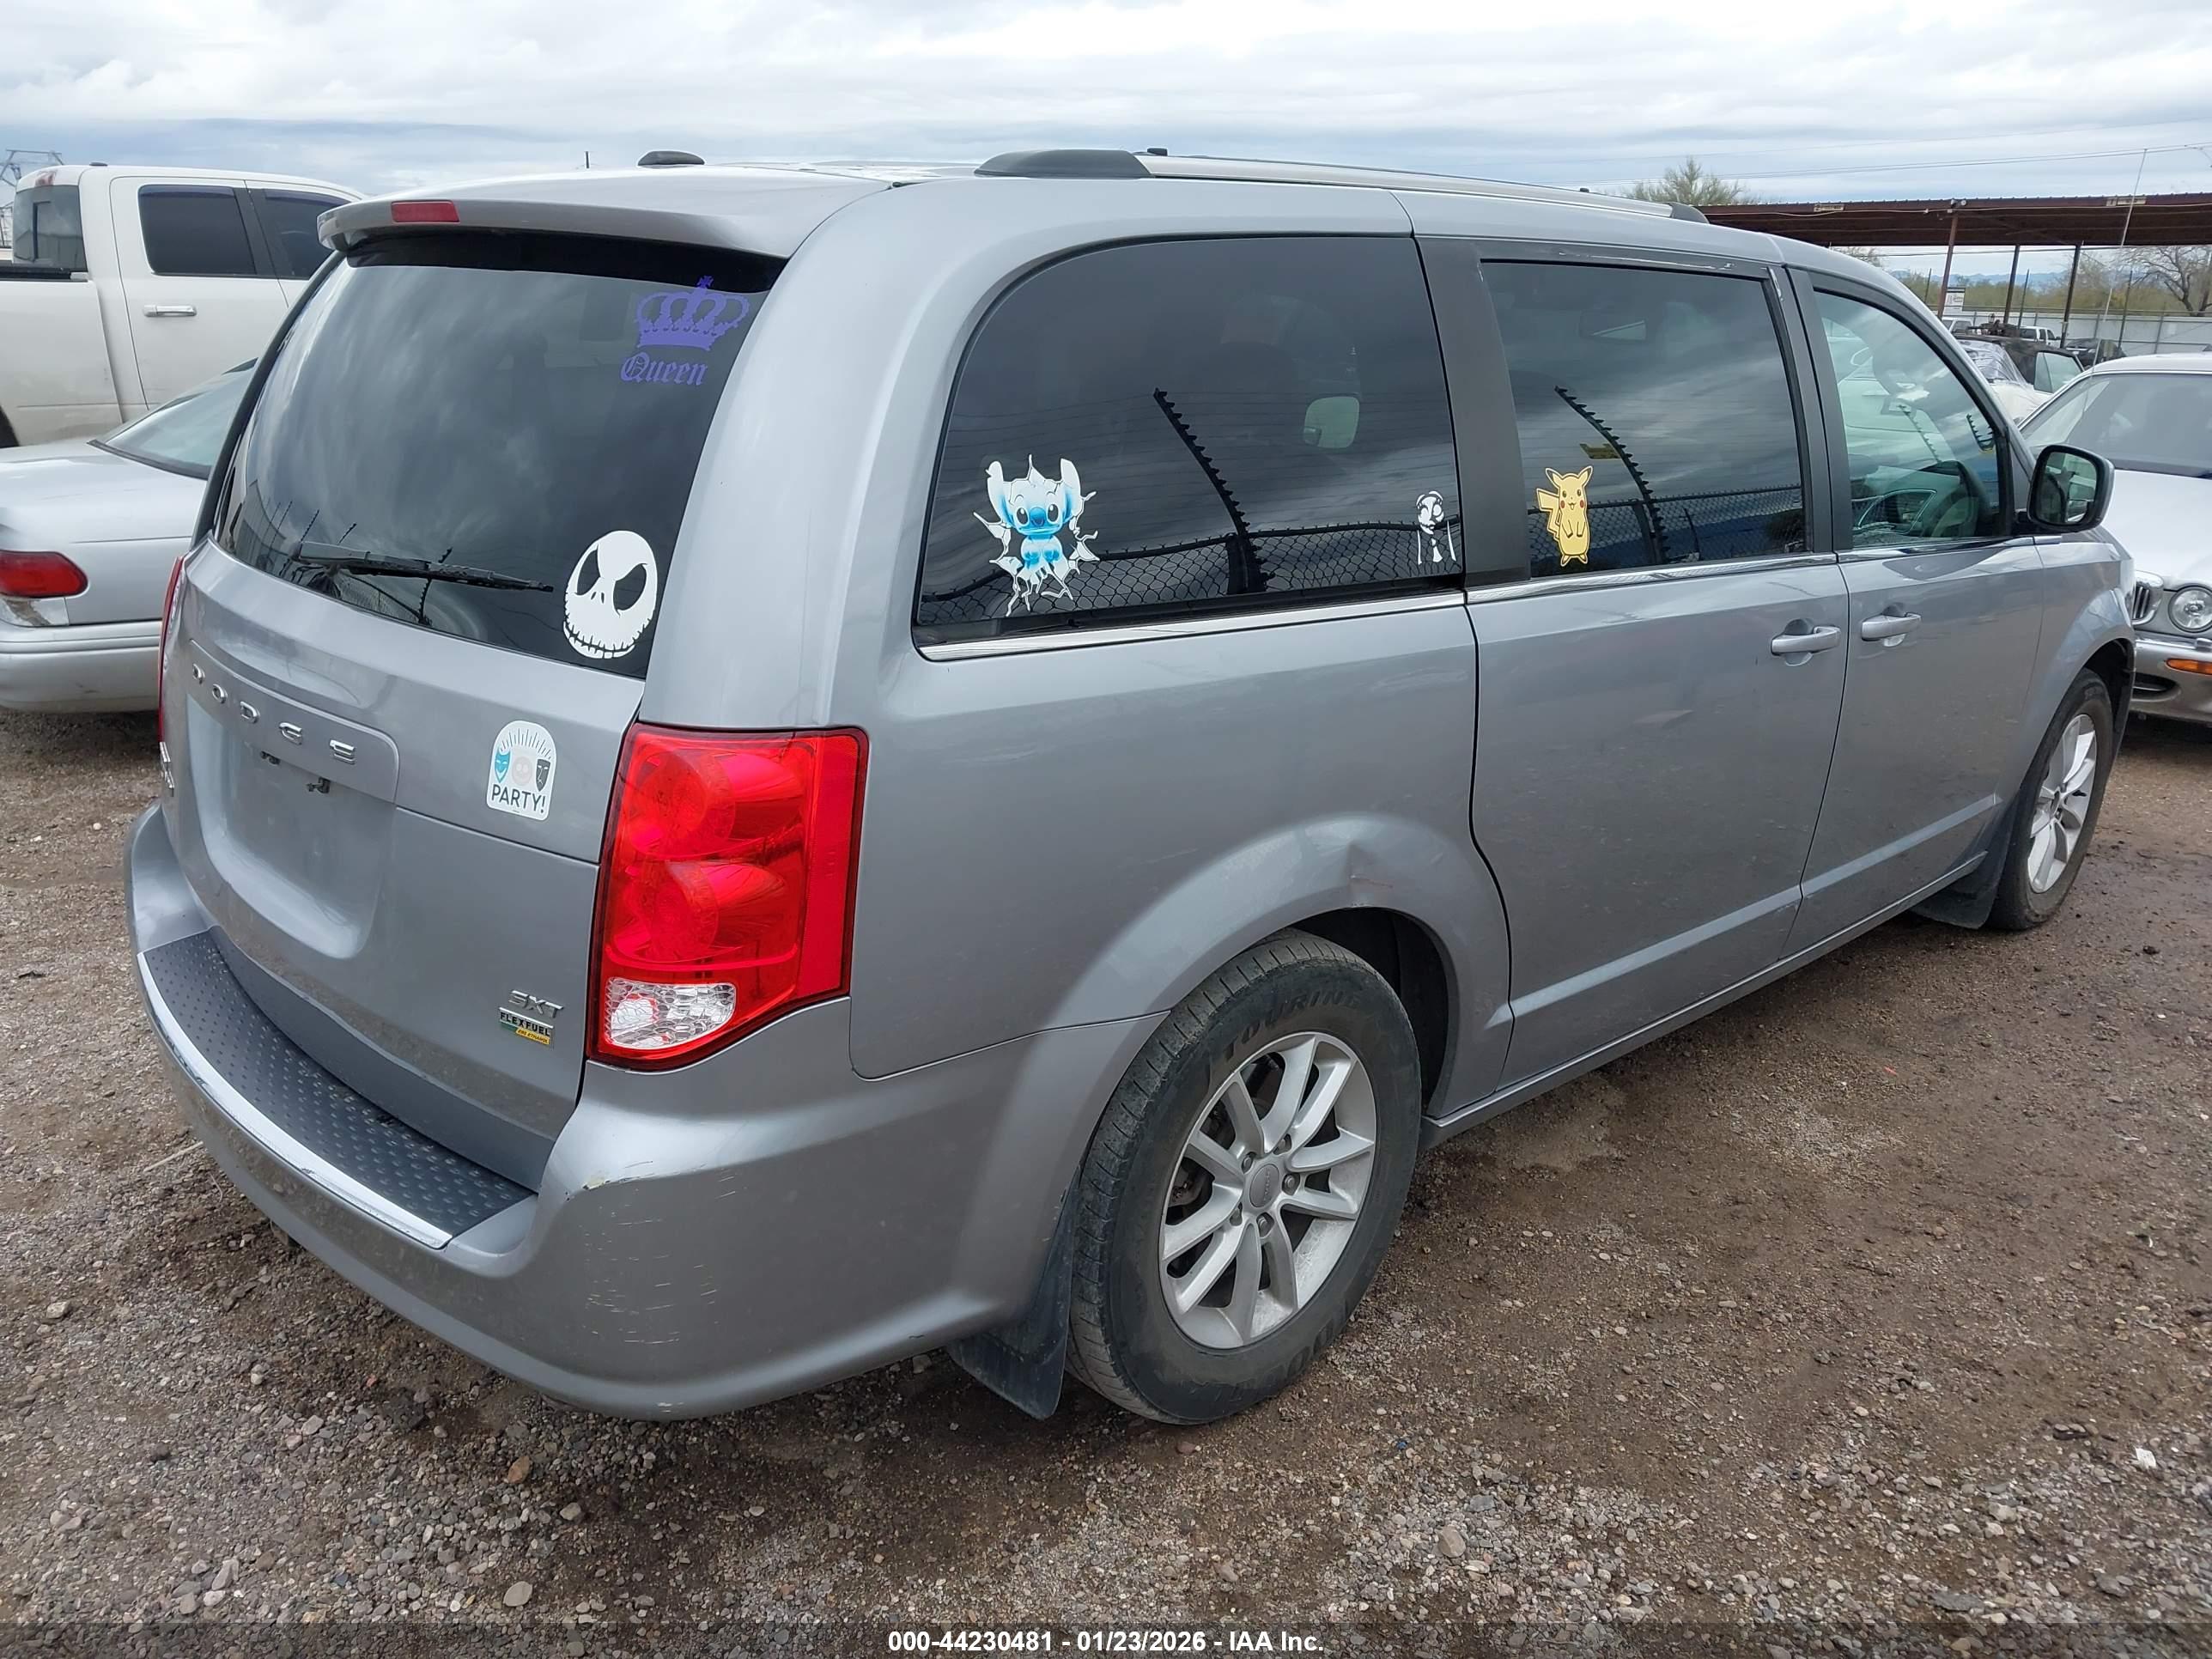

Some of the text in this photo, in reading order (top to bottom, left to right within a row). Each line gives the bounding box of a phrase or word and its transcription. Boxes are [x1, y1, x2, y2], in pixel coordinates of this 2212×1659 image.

[620, 352, 708, 386] Queen
[192, 662, 356, 765] DODGE
[491, 783, 546, 813] PARTY!
[508, 989, 564, 1018] SXT
